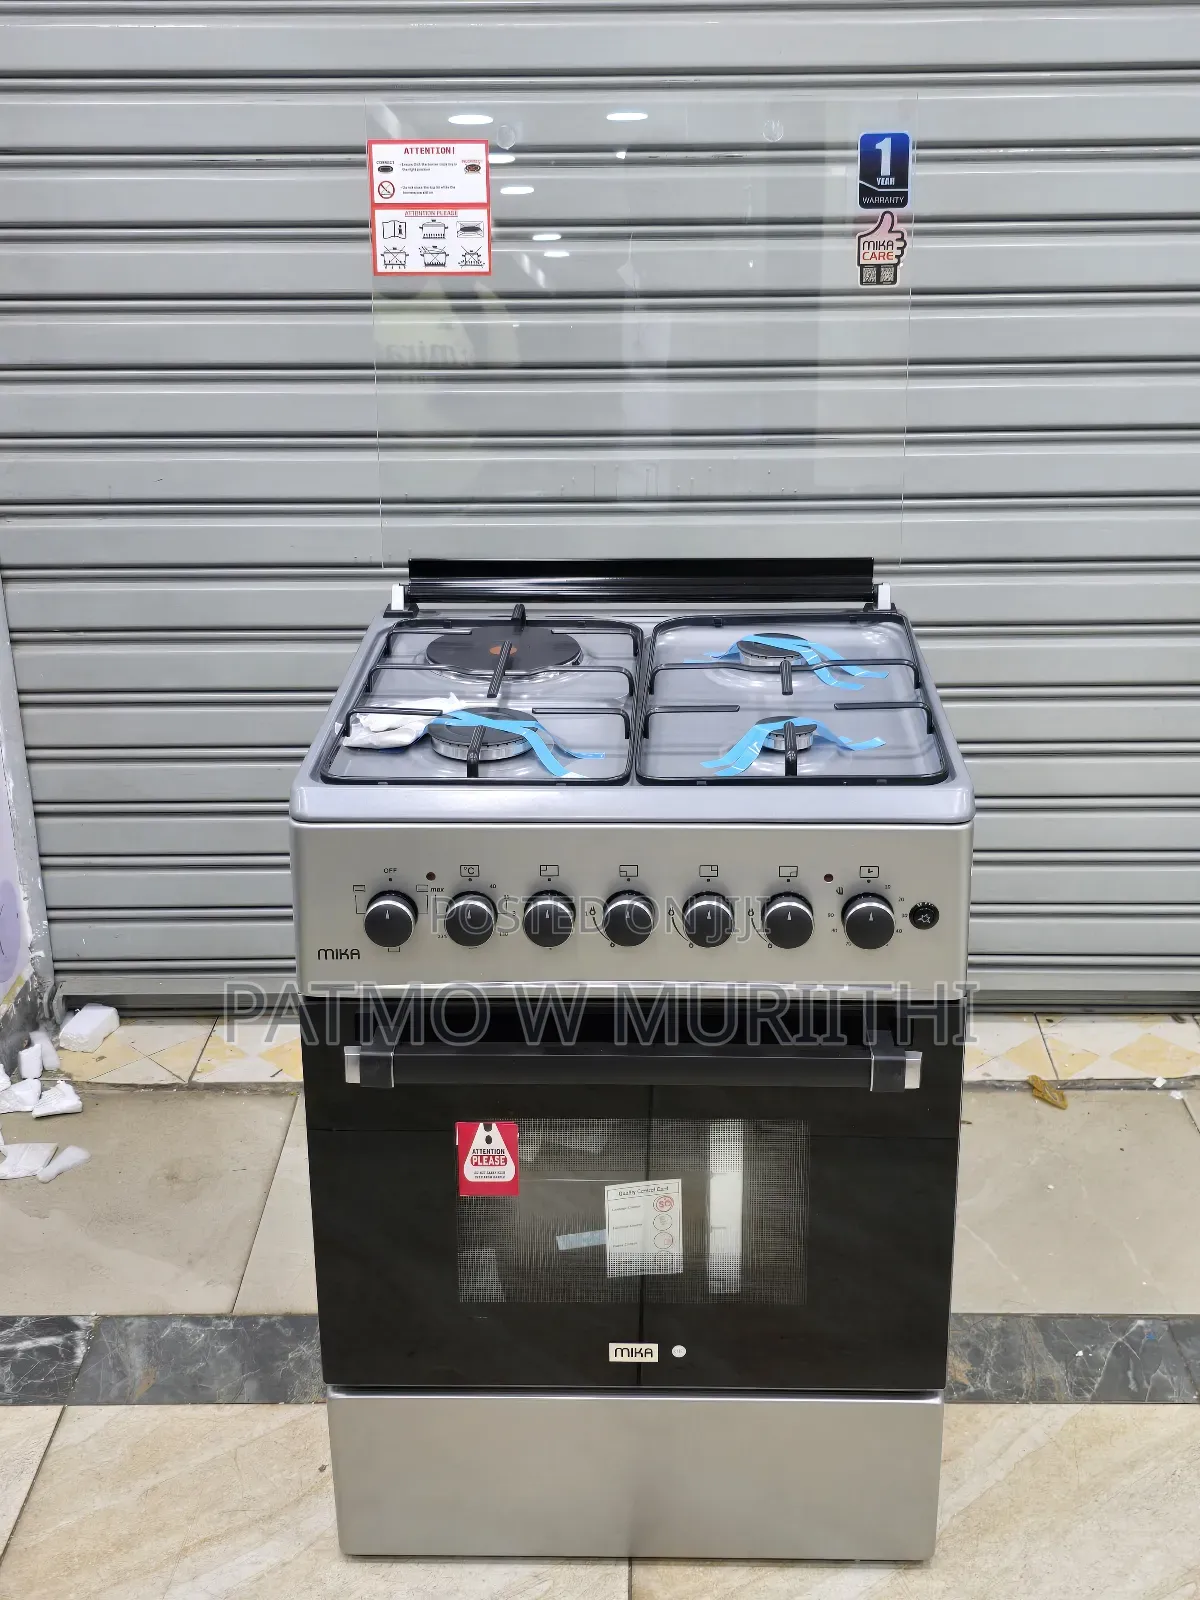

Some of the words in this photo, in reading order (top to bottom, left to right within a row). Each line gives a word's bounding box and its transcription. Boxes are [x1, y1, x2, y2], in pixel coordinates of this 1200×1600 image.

[403, 147, 455, 155] ATTENTION!
[875, 137, 892, 176] 1
[876, 177, 895, 186] YEAR
[862, 196, 905, 204] WARRANTY
[862, 240, 894, 251] MIKA
[862, 251, 894, 261] CARE
[317, 948, 361, 961] MIKA
[472, 1155, 506, 1166] PLEASE
[614, 1347, 654, 1358] MIKA
